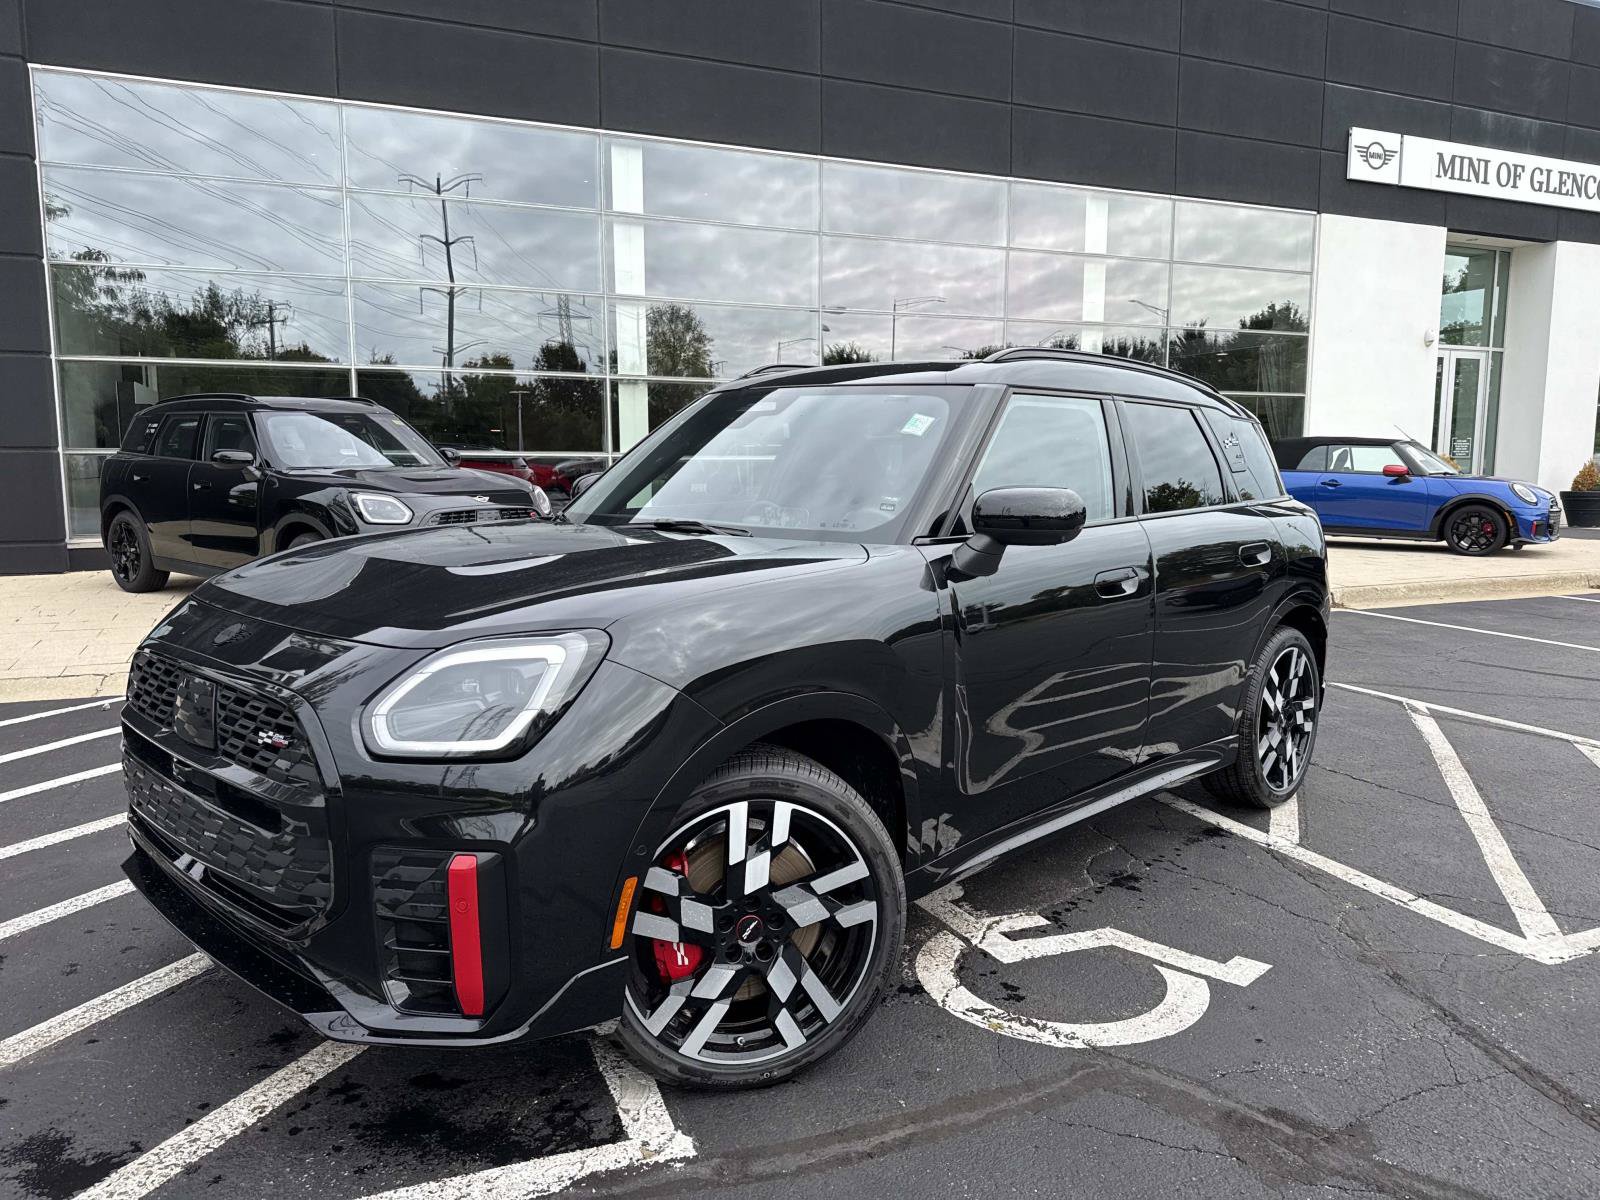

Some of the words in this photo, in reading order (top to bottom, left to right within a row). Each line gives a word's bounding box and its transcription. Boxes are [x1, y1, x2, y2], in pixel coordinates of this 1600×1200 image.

[1368, 151, 1384, 160] MINI
[1435, 152, 1491, 185] MINI
[1496, 161, 1525, 189] OF
[1530, 166, 1600, 201] GLENC
